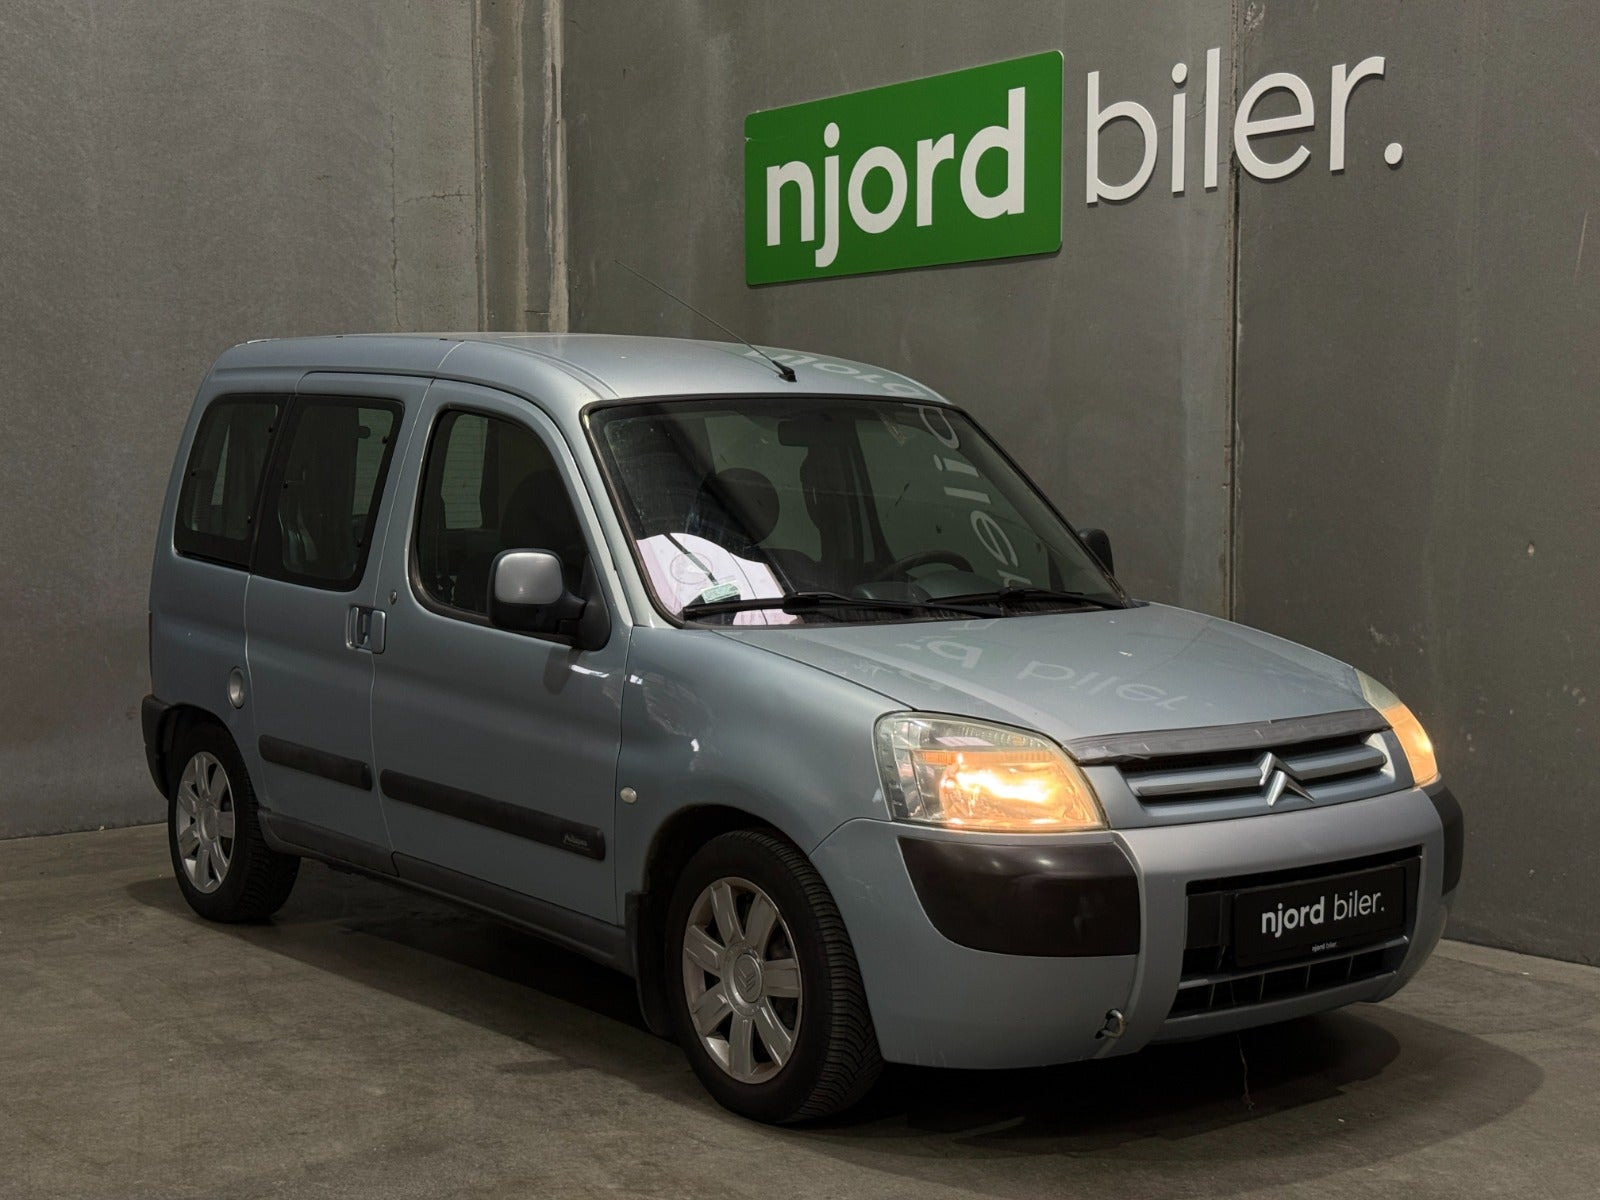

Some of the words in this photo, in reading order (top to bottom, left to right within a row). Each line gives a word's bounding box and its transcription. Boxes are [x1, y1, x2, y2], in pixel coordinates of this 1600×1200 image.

[765, 86, 1026, 268] njord
[1086, 47, 1403, 205] biler.
[1261, 895, 1325, 938] njord
[1333, 889, 1385, 921] biler.
